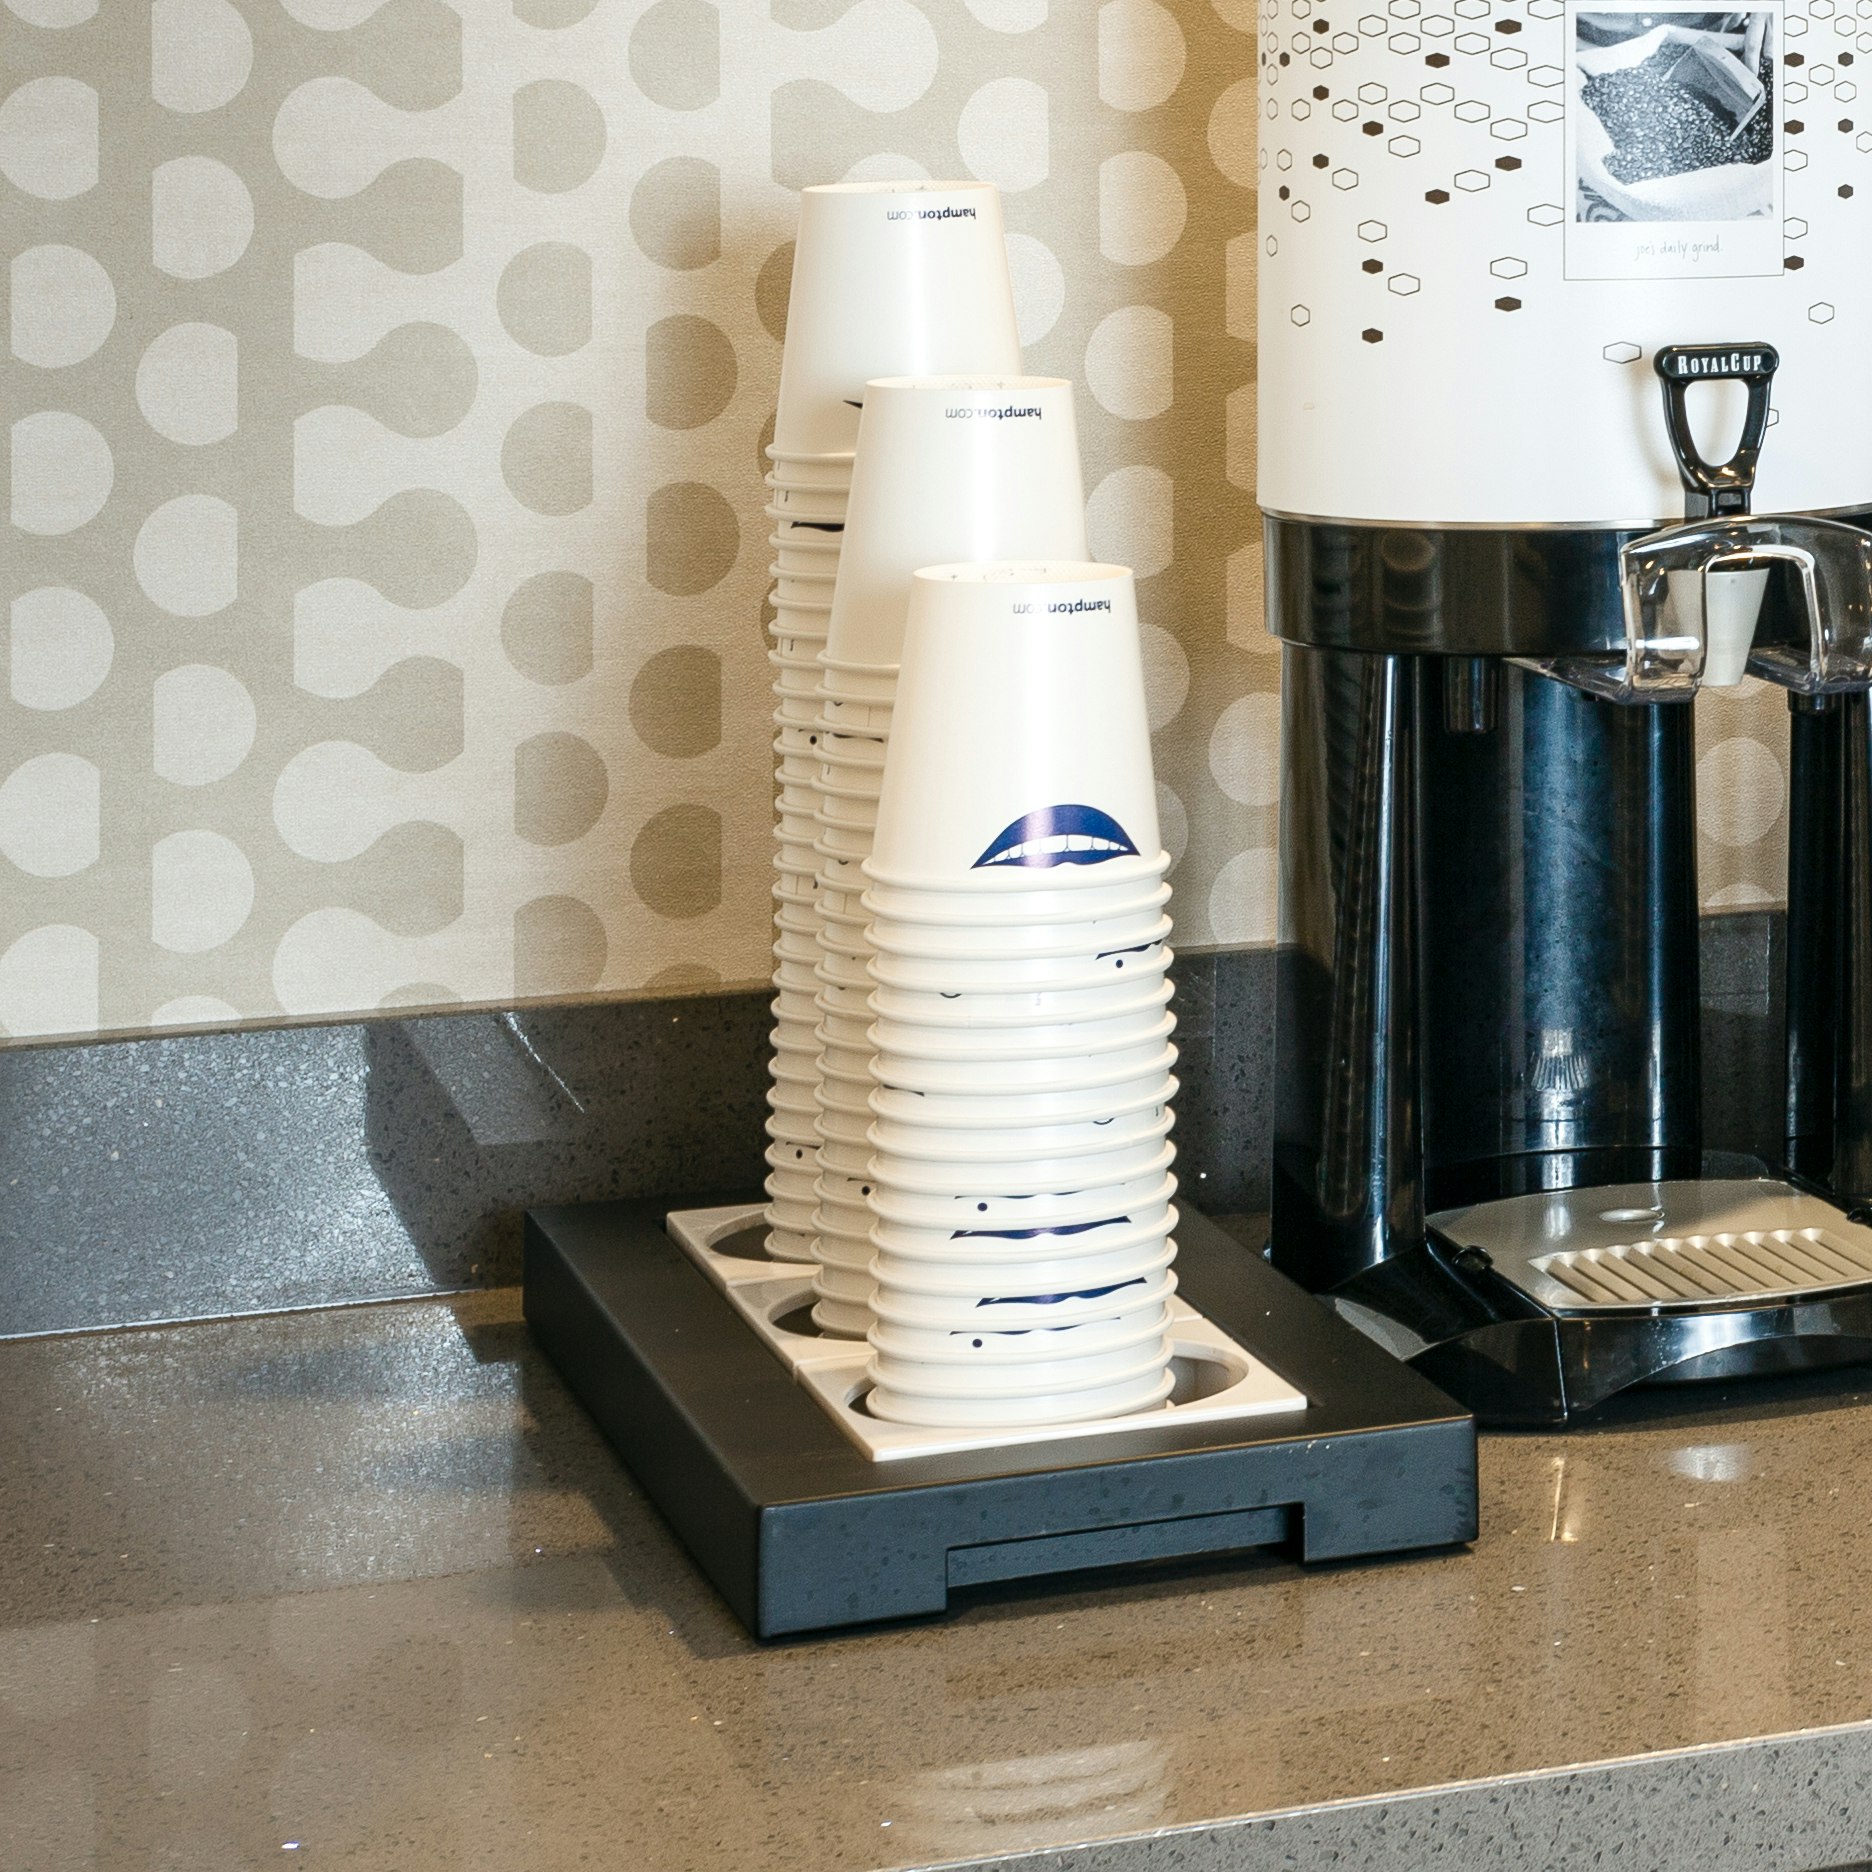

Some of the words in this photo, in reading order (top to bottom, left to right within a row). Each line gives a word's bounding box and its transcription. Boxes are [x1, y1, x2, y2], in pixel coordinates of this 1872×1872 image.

[886, 207, 976, 221] hampton.com
[1659, 239, 1688, 260] daily
[945, 405, 1042, 421] hampton.com
[1012, 598, 1112, 615] hamptonom
